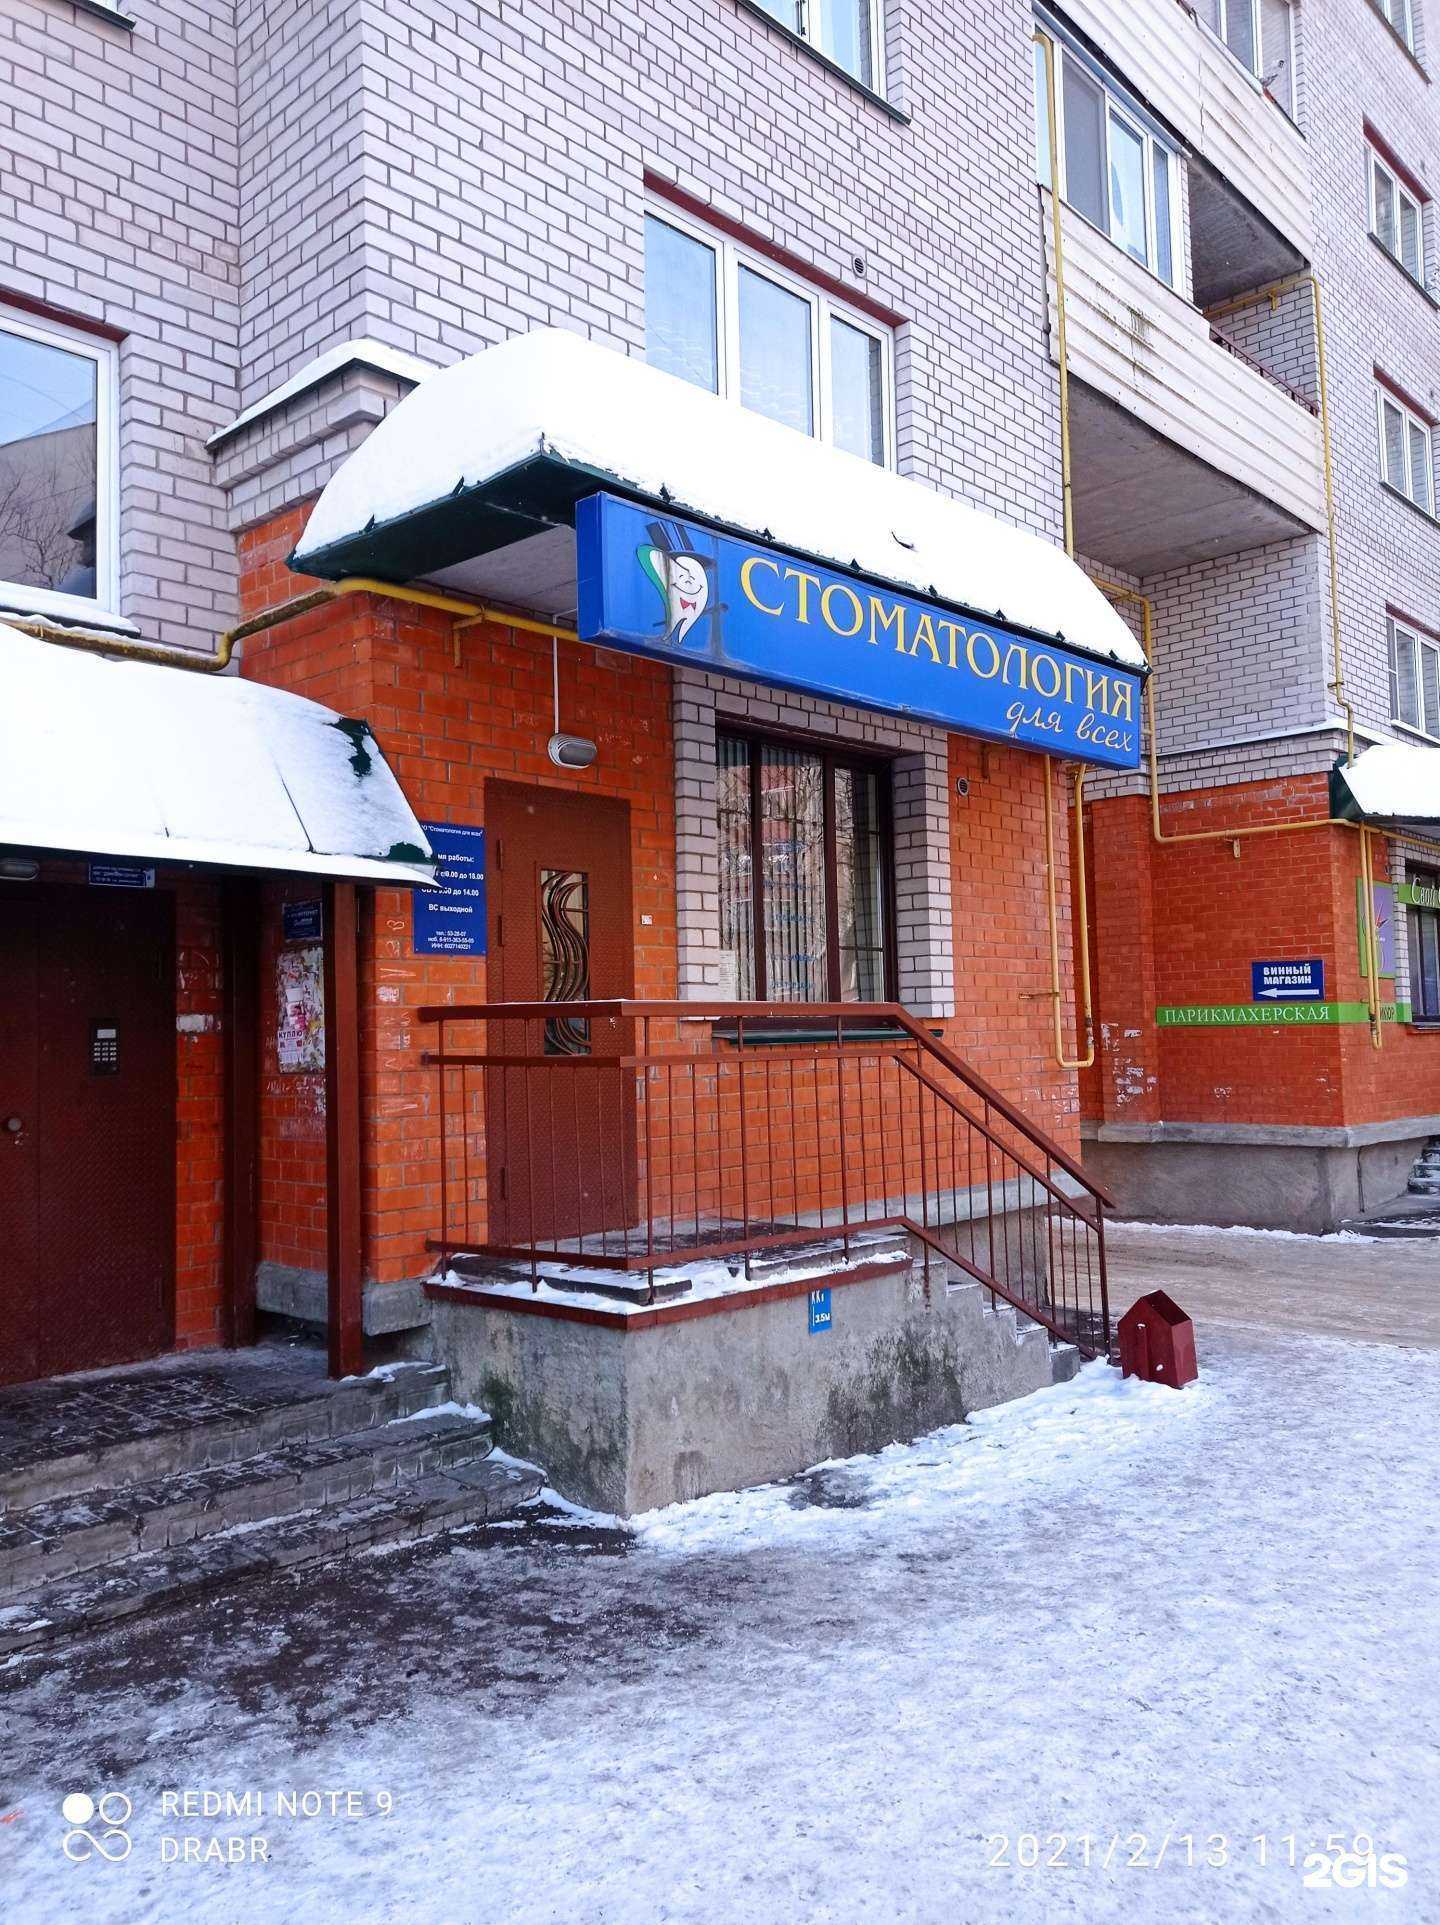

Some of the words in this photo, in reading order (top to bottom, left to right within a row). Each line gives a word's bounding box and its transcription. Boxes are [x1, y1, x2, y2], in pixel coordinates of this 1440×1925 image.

[740, 557, 1133, 721] СТОМАТОЛОГИЯ
[1005, 701, 1062, 738] для
[1076, 719, 1133, 752] всех
[428, 903, 439, 911] ВС
[440, 904, 473, 913] выходной
[1263, 963, 1312, 975] ВИННЫЙ
[1263, 975, 1312, 985] МАГАЗИН
[1165, 1006, 1330, 1023] ПАРИКМАХЕРСКАЯ
[278, 1030, 303, 1039] КУПЛЮ
